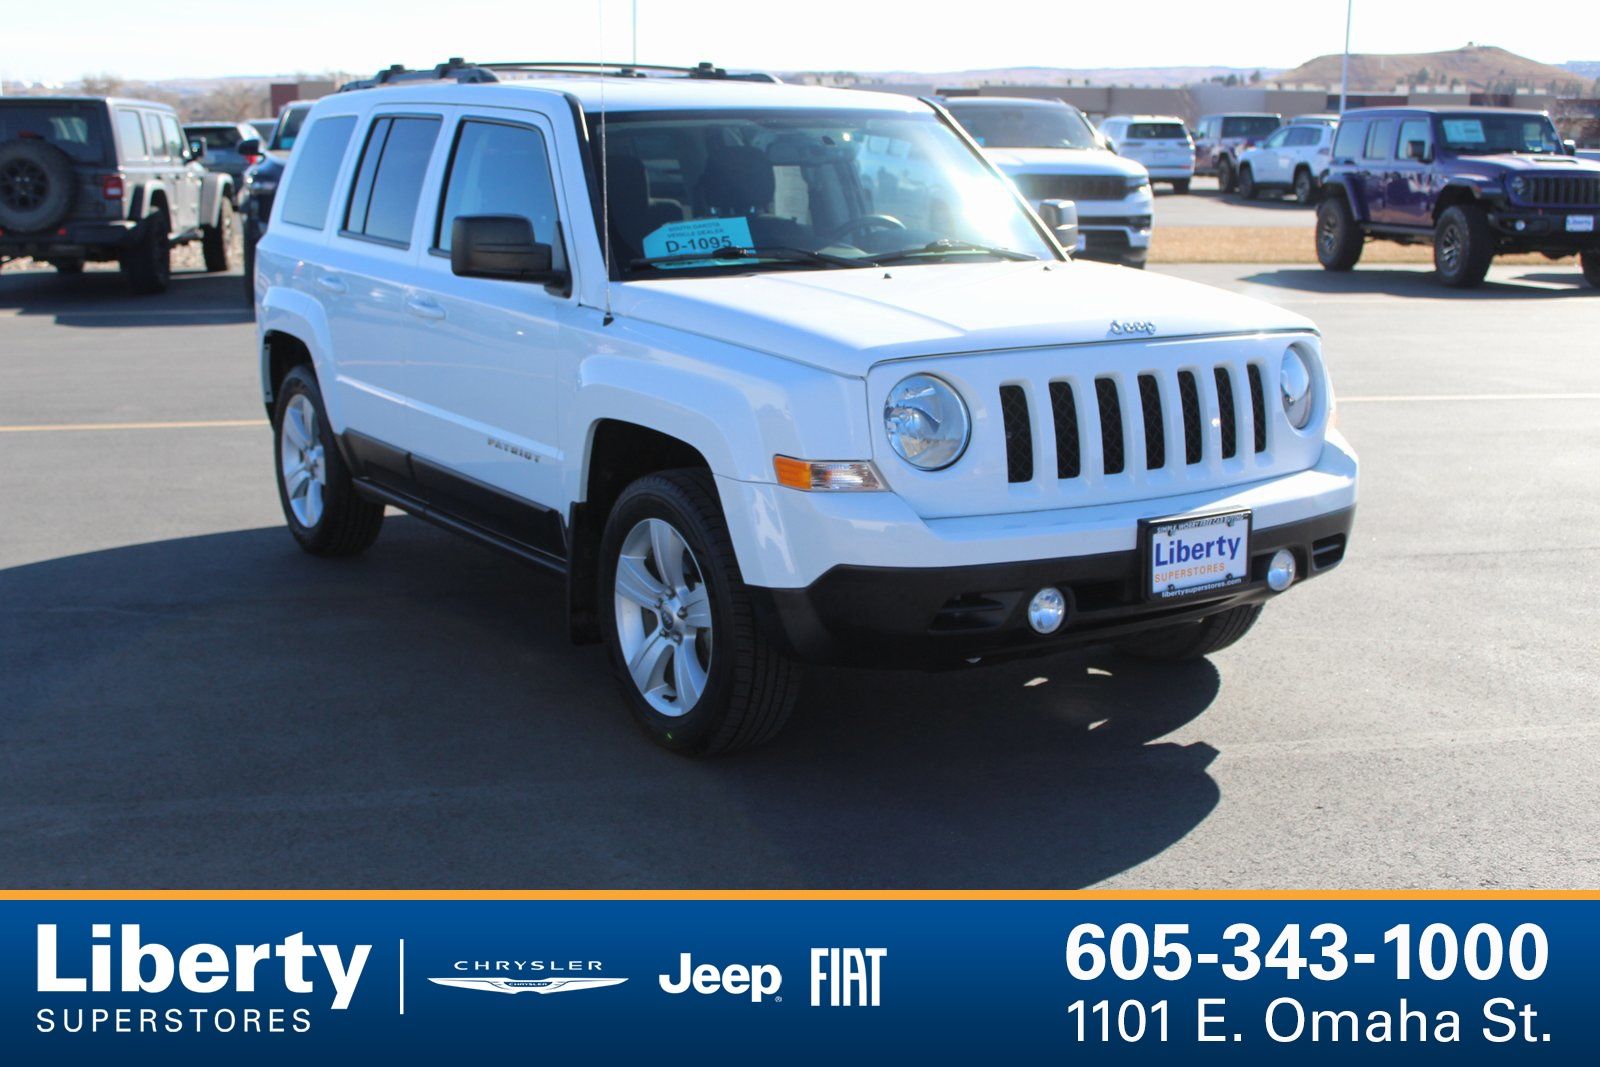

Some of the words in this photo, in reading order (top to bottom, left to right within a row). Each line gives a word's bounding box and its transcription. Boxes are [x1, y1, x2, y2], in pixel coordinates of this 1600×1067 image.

[693, 222, 720, 230] DAKOTA
[665, 235, 732, 253] D-1095
[1109, 319, 1157, 336] Jeep
[487, 437, 541, 463] PATRIOT
[1155, 535, 1241, 567] Liberty
[1154, 562, 1226, 583] SUPERSTORES
[1161, 578, 1242, 598] libertysuperstores.com
